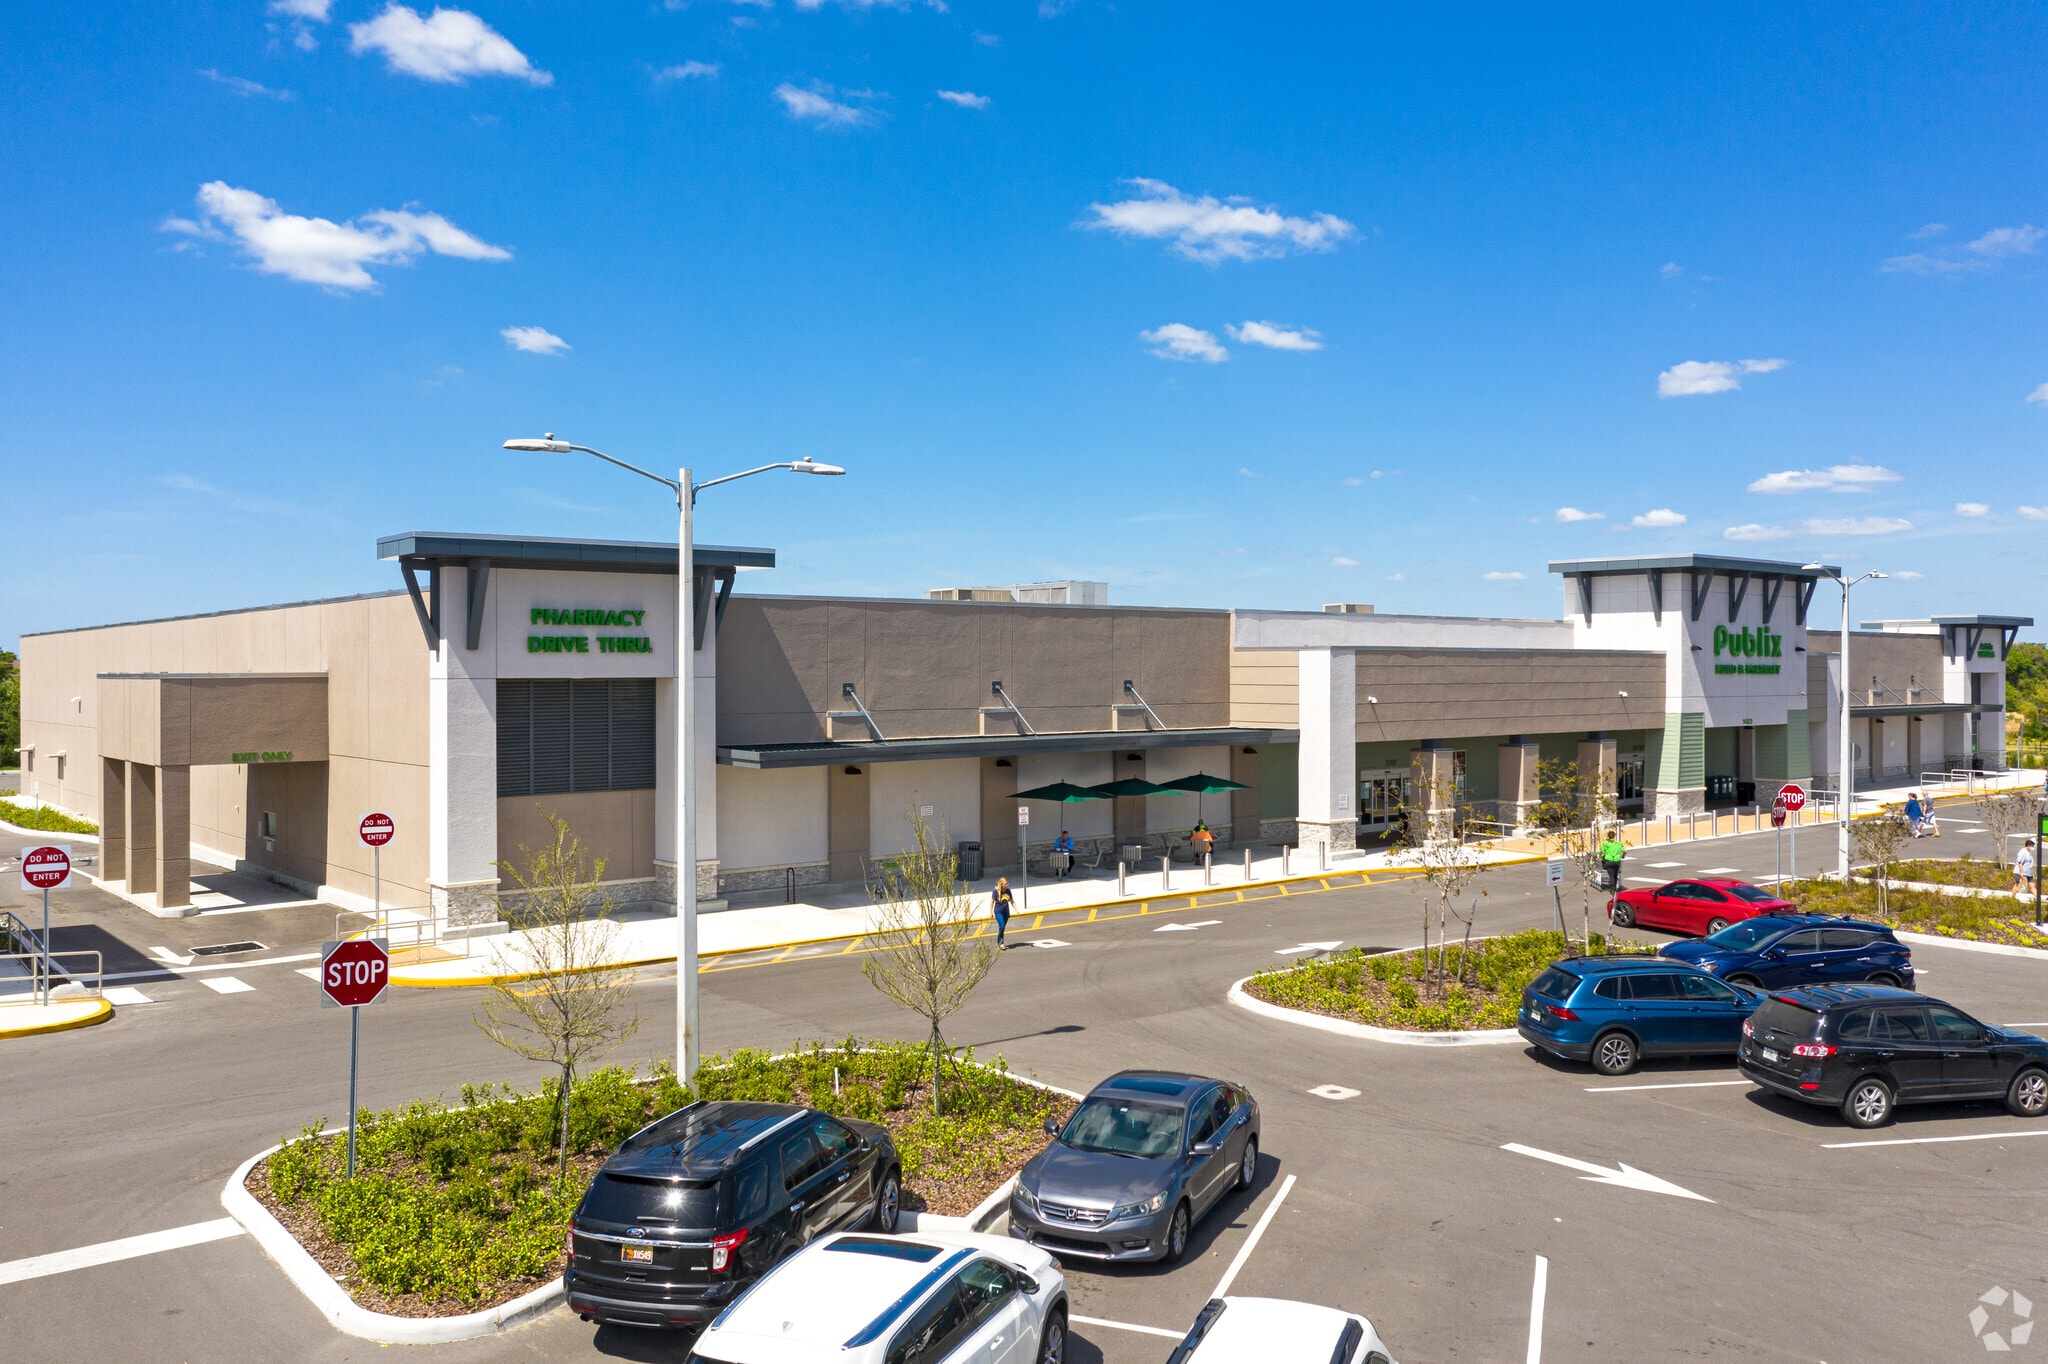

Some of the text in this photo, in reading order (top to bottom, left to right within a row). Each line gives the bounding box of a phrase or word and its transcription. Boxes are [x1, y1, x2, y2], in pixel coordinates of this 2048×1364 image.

[530, 608, 646, 626] PHARMACY
[527, 636, 650, 653] DRIVE THRU
[1713, 624, 1783, 657] Publix
[232, 750, 292, 763] EXIT ONLY
[1780, 792, 1804, 804] STOP
[367, 833, 387, 841] ENTER
[29, 853, 64, 863] DO NOT
[32, 872, 60, 881] ENTER
[327, 959, 385, 987] STOP
